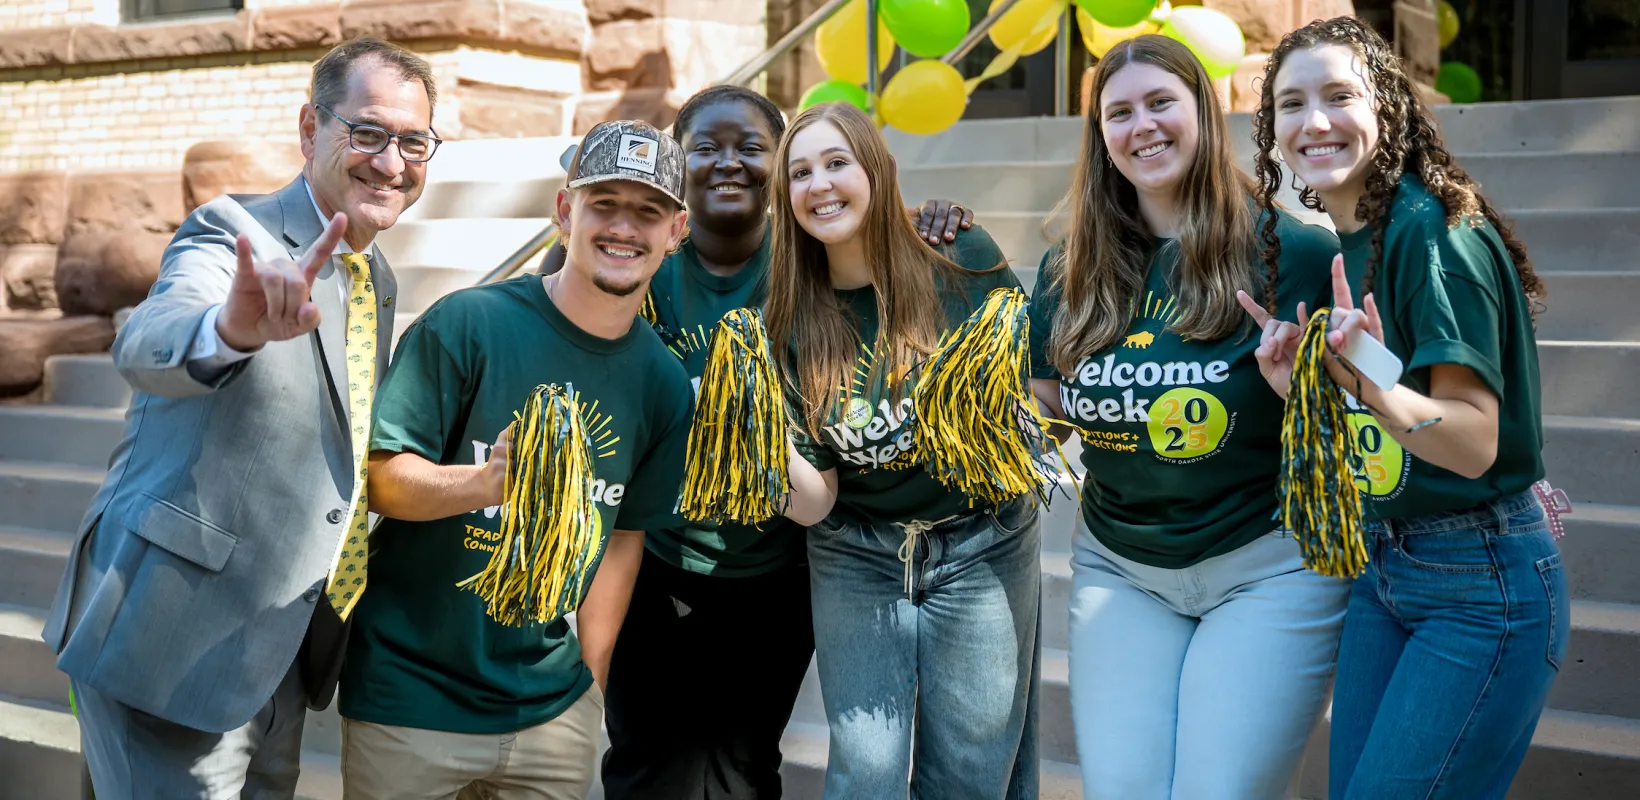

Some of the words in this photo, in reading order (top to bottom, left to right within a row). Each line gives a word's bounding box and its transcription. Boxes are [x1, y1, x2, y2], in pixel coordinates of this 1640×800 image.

[620, 156, 653, 167] HENNING
[1060, 381, 1152, 422] Week
[1161, 397, 1209, 426] 20
[1155, 454, 1176, 464] NORTH
[1178, 456, 1204, 465] DAKOTA
[1204, 449, 1222, 459] STATE
[1219, 411, 1238, 448] UNIVERSITY
[1164, 425, 1209, 453] 25
[1401, 451, 1412, 487] UNIVERSIT
